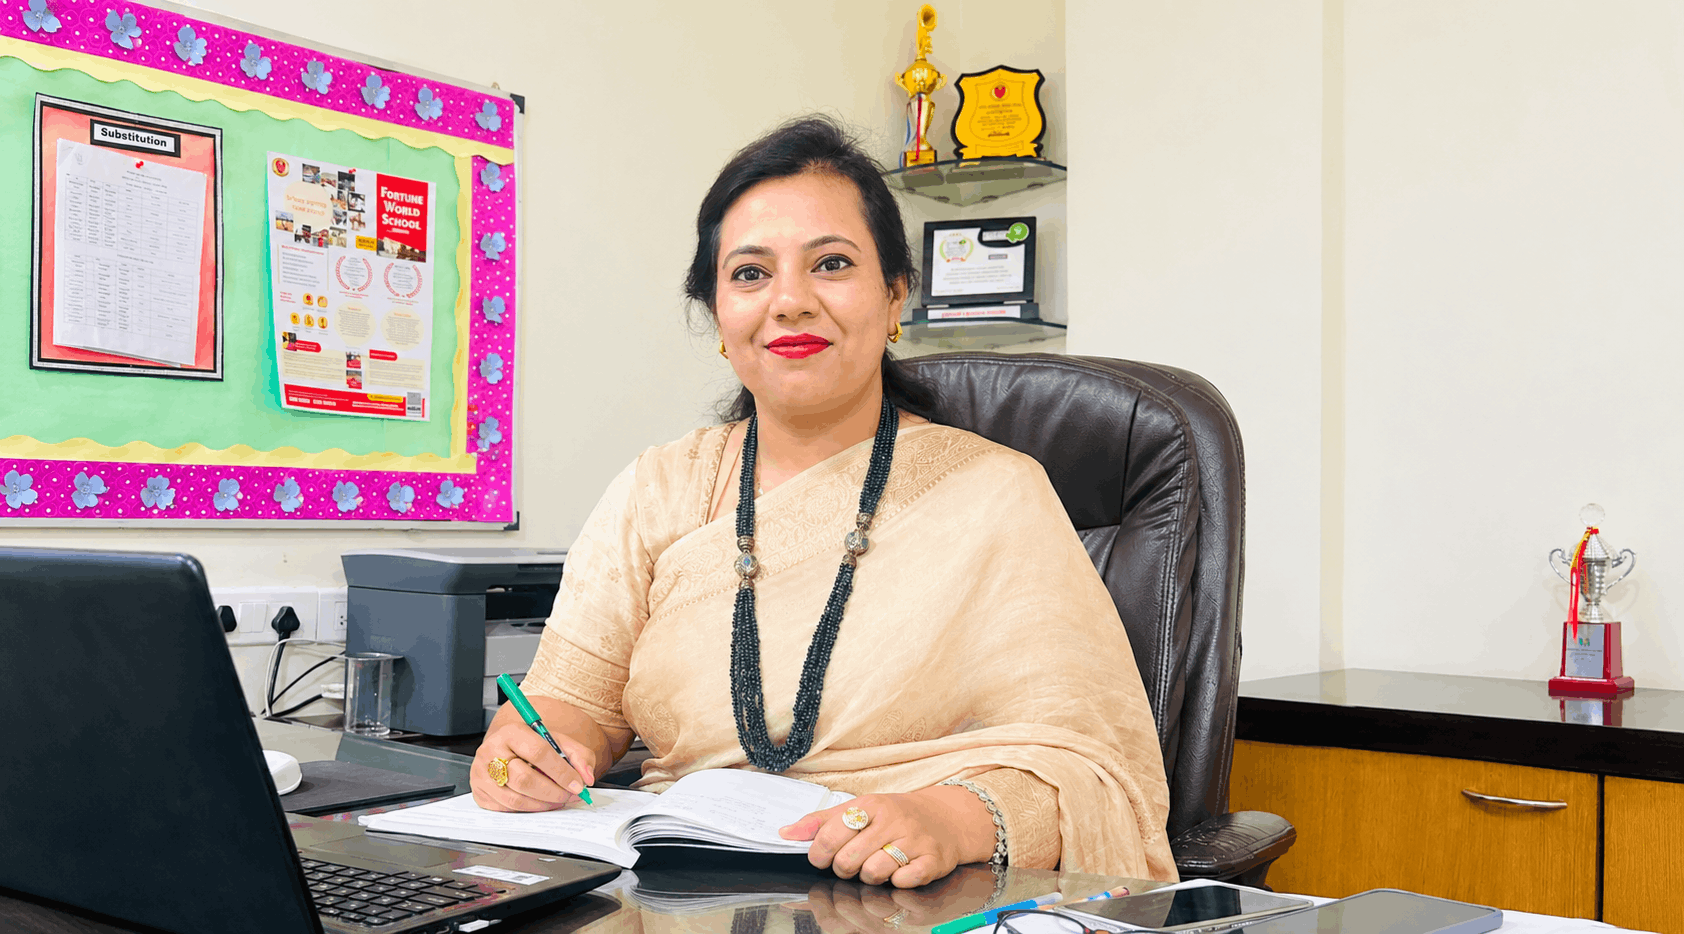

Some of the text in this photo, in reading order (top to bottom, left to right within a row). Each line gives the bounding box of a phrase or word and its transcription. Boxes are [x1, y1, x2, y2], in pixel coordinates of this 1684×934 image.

[100, 127, 167, 147] Substitution
[380, 186, 424, 205] FORTUNE
[383, 200, 420, 217] WORLD
[381, 213, 421, 230] SCHOOL
